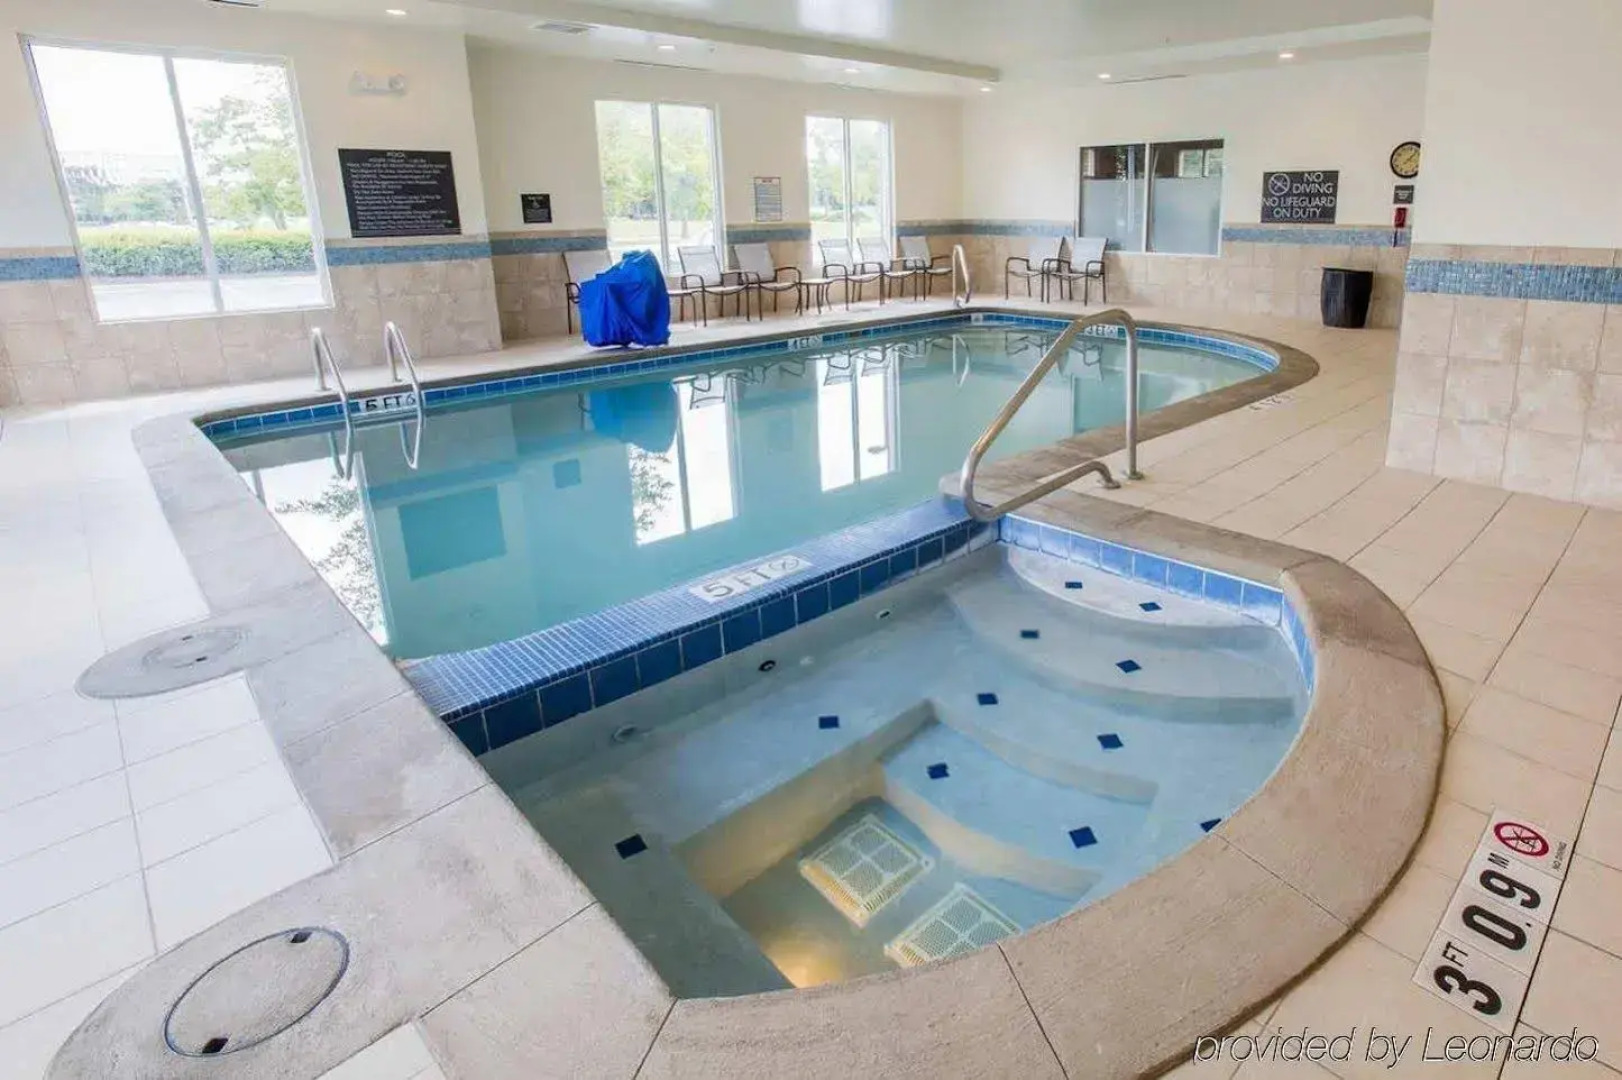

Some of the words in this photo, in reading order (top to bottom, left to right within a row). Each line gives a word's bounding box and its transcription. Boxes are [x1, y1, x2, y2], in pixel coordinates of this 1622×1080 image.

[1304, 172, 1324, 182] NO
[1292, 183, 1334, 194] DIVING
[1262, 197, 1279, 207] NO
[1280, 196, 1336, 208] LIFEGUARD
[1273, 207, 1290, 218] ON
[1293, 207, 1321, 218] DUTY
[383, 395, 402, 409] FT
[702, 583, 733, 597] 5
[733, 568, 771, 586] FT
[1487, 852, 1510, 869] M
[1442, 941, 1468, 967] FT
[1434, 965, 1502, 1015] 3
